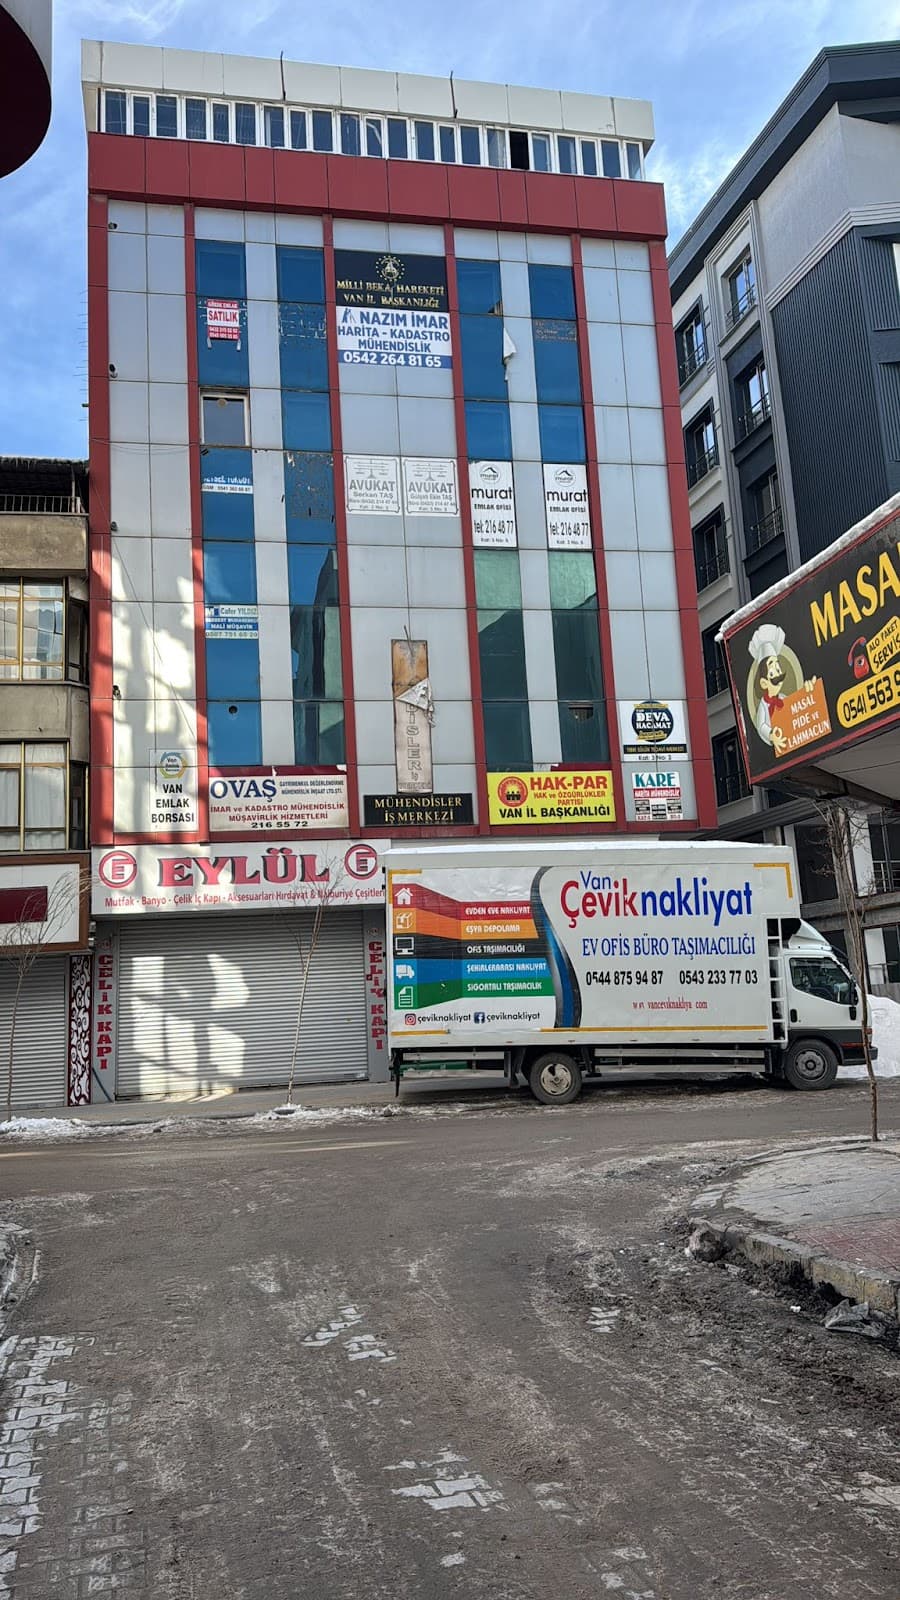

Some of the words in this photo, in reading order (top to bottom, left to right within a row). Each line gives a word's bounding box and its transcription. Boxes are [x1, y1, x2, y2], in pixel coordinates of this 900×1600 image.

[366, 282, 392, 292] BEKA
[396, 284, 445, 296] HAREKETİ
[343, 294, 364, 303] VAN
[366, 293, 376, 304] İL
[208, 310, 238, 322] SATILIK
[360, 311, 407, 327] NAZIM
[411, 312, 449, 329] İMAR
[337, 325, 380, 338] HARİTA
[390, 329, 450, 342] KADASTRO
[358, 338, 431, 353] MÜHENDİSLİK
[343, 351, 378, 364] 0542
[380, 353, 405, 366] 264
[408, 355, 422, 367] 81
[425, 356, 442, 367] 65
[349, 479, 396, 492] AVUKAT
[408, 482, 454, 493] AVUKAT
[471, 487, 513, 500] murat
[546, 489, 588, 502] murat
[474, 520, 484, 534] tel:
[485, 520, 496, 534] 216
[498, 520, 505, 534] 48
[506, 521, 514, 534] 77
[549, 522, 559, 536] tel:
[560, 522, 571, 536] 216
[573, 522, 580, 536] 48
[581, 523, 589, 536] 77
[810, 541, 900, 647] MASA
[869, 638, 880, 652] ALO
[790, 694, 816, 715] MASAL
[843, 693, 867, 722] 0541
[866, 675, 893, 711] 563
[636, 712, 670, 722] DEVA
[792, 712, 811, 730] PİDE
[788, 720, 830, 748] LAHMACUN
[530, 776, 608, 791] HAK-PAR
[635, 773, 676, 787] KARE
[162, 783, 183, 794] VAN
[210, 779, 277, 803] OVAŞ
[557, 790, 606, 799] ÖZGÜRLÜKLER
[155, 798, 190, 808] EMLAK
[245, 804, 288, 812] KADASTRO
[290, 802, 345, 811] MÜHENDİSLİK
[374, 796, 462, 809] MÜHENDİSLER
[151, 812, 195, 823] BORSASI
[229, 812, 278, 823] MÜŞAVİRLİK
[281, 812, 328, 820] HİZMETLERİ
[384, 810, 396, 824] İŞ
[398, 809, 454, 822] MERKEZİ
[499, 808, 522, 818] VAN
[526, 806, 537, 817] İL
[541, 804, 610, 819] BAŞKANLIĞI
[157, 847, 330, 887] EYLÜL
[580, 870, 611, 889] Van
[105, 896, 134, 907] Mutfak
[141, 895, 167, 907] Banyo
[173, 894, 193, 907] Çelik
[203, 893, 221, 905] Kapı
[227, 891, 273, 902] Aksesuarları
[276, 891, 308, 900] Hırdavat
[465, 906, 486, 915] EVDEN
[487, 906, 499, 915] EVE
[465, 925, 483, 935] EŞYA
[484, 924, 520, 932] DEPOLAMA
[483, 943, 526, 955] TAŞIMACILIĞI
[582, 938, 598, 956] EV
[601, 933, 629, 956] OFİS
[633, 933, 669, 956] BÜRO
[672, 933, 756, 960] TAŞIMACILIĞI
[586, 971, 611, 985] 0544
[613, 971, 633, 985] 875
[635, 971, 649, 985] 94
[651, 970, 664, 984] 87
[679, 970, 704, 984] 0543
[707, 970, 726, 984] 233
[729, 970, 742, 984] 77
[745, 970, 758, 984] 03
[417, 1012, 471, 1024] çeviknakliyat
[486, 1011, 540, 1023] çeviknakliyat
[371, 1004, 385, 1049] KAPI
[97, 1021, 113, 1070] KAPI
